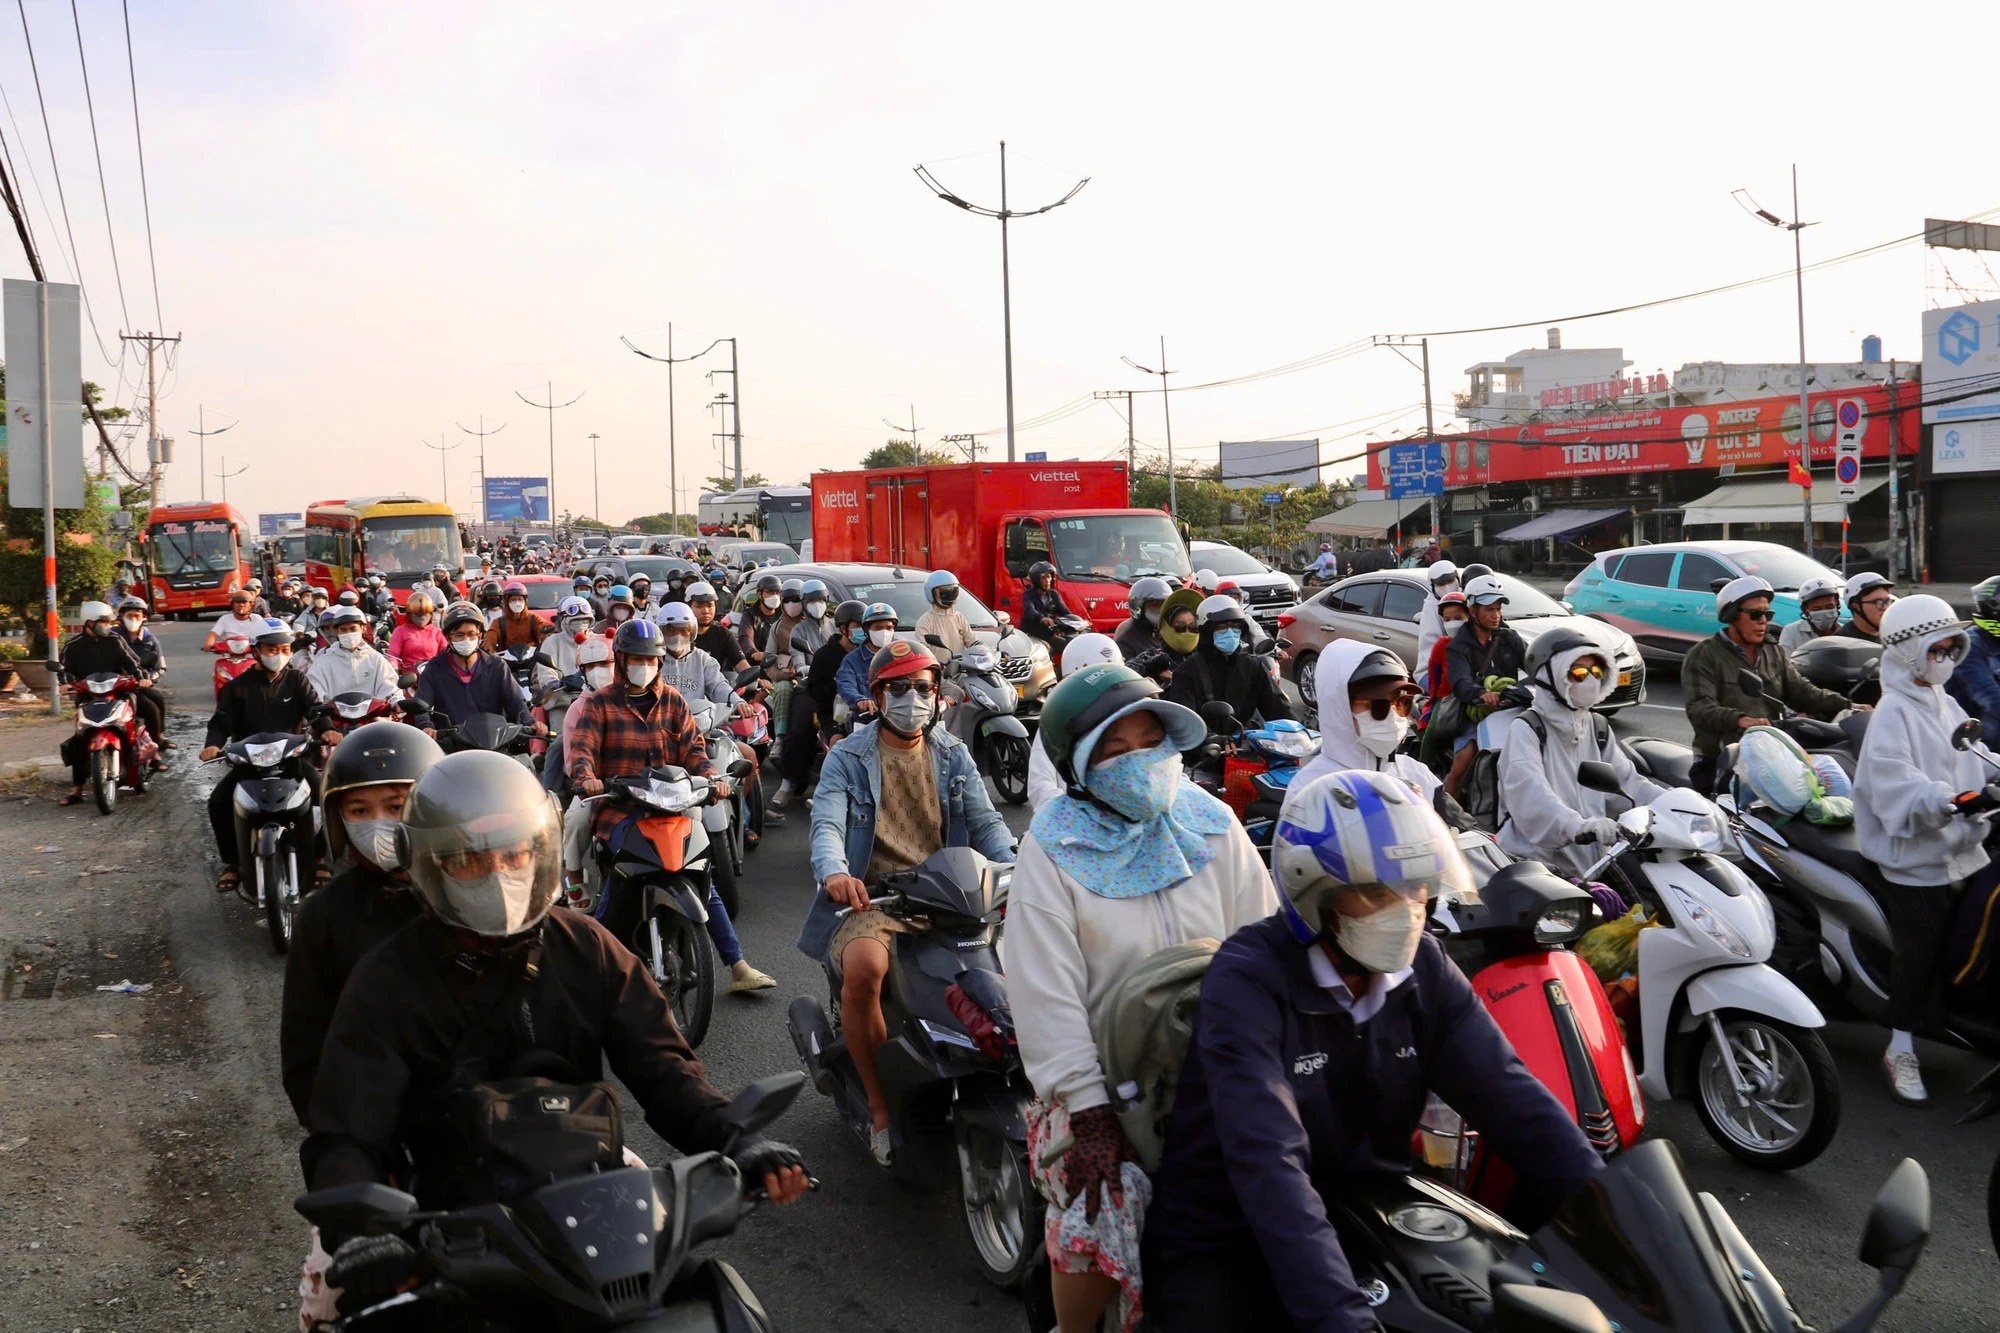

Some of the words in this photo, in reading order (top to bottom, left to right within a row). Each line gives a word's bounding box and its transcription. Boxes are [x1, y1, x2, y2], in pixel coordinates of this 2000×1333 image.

[1717, 407, 1761, 424] MRF
[1561, 437, 1601, 465] TIẾN
[1029, 471, 1081, 482] viettel
[1063, 485, 1081, 493] post
[820, 490, 859, 508] viettel
[846, 513, 860, 525] post
[1246, 816, 1267, 824] HONDA
[957, 940, 987, 948] HONDA
